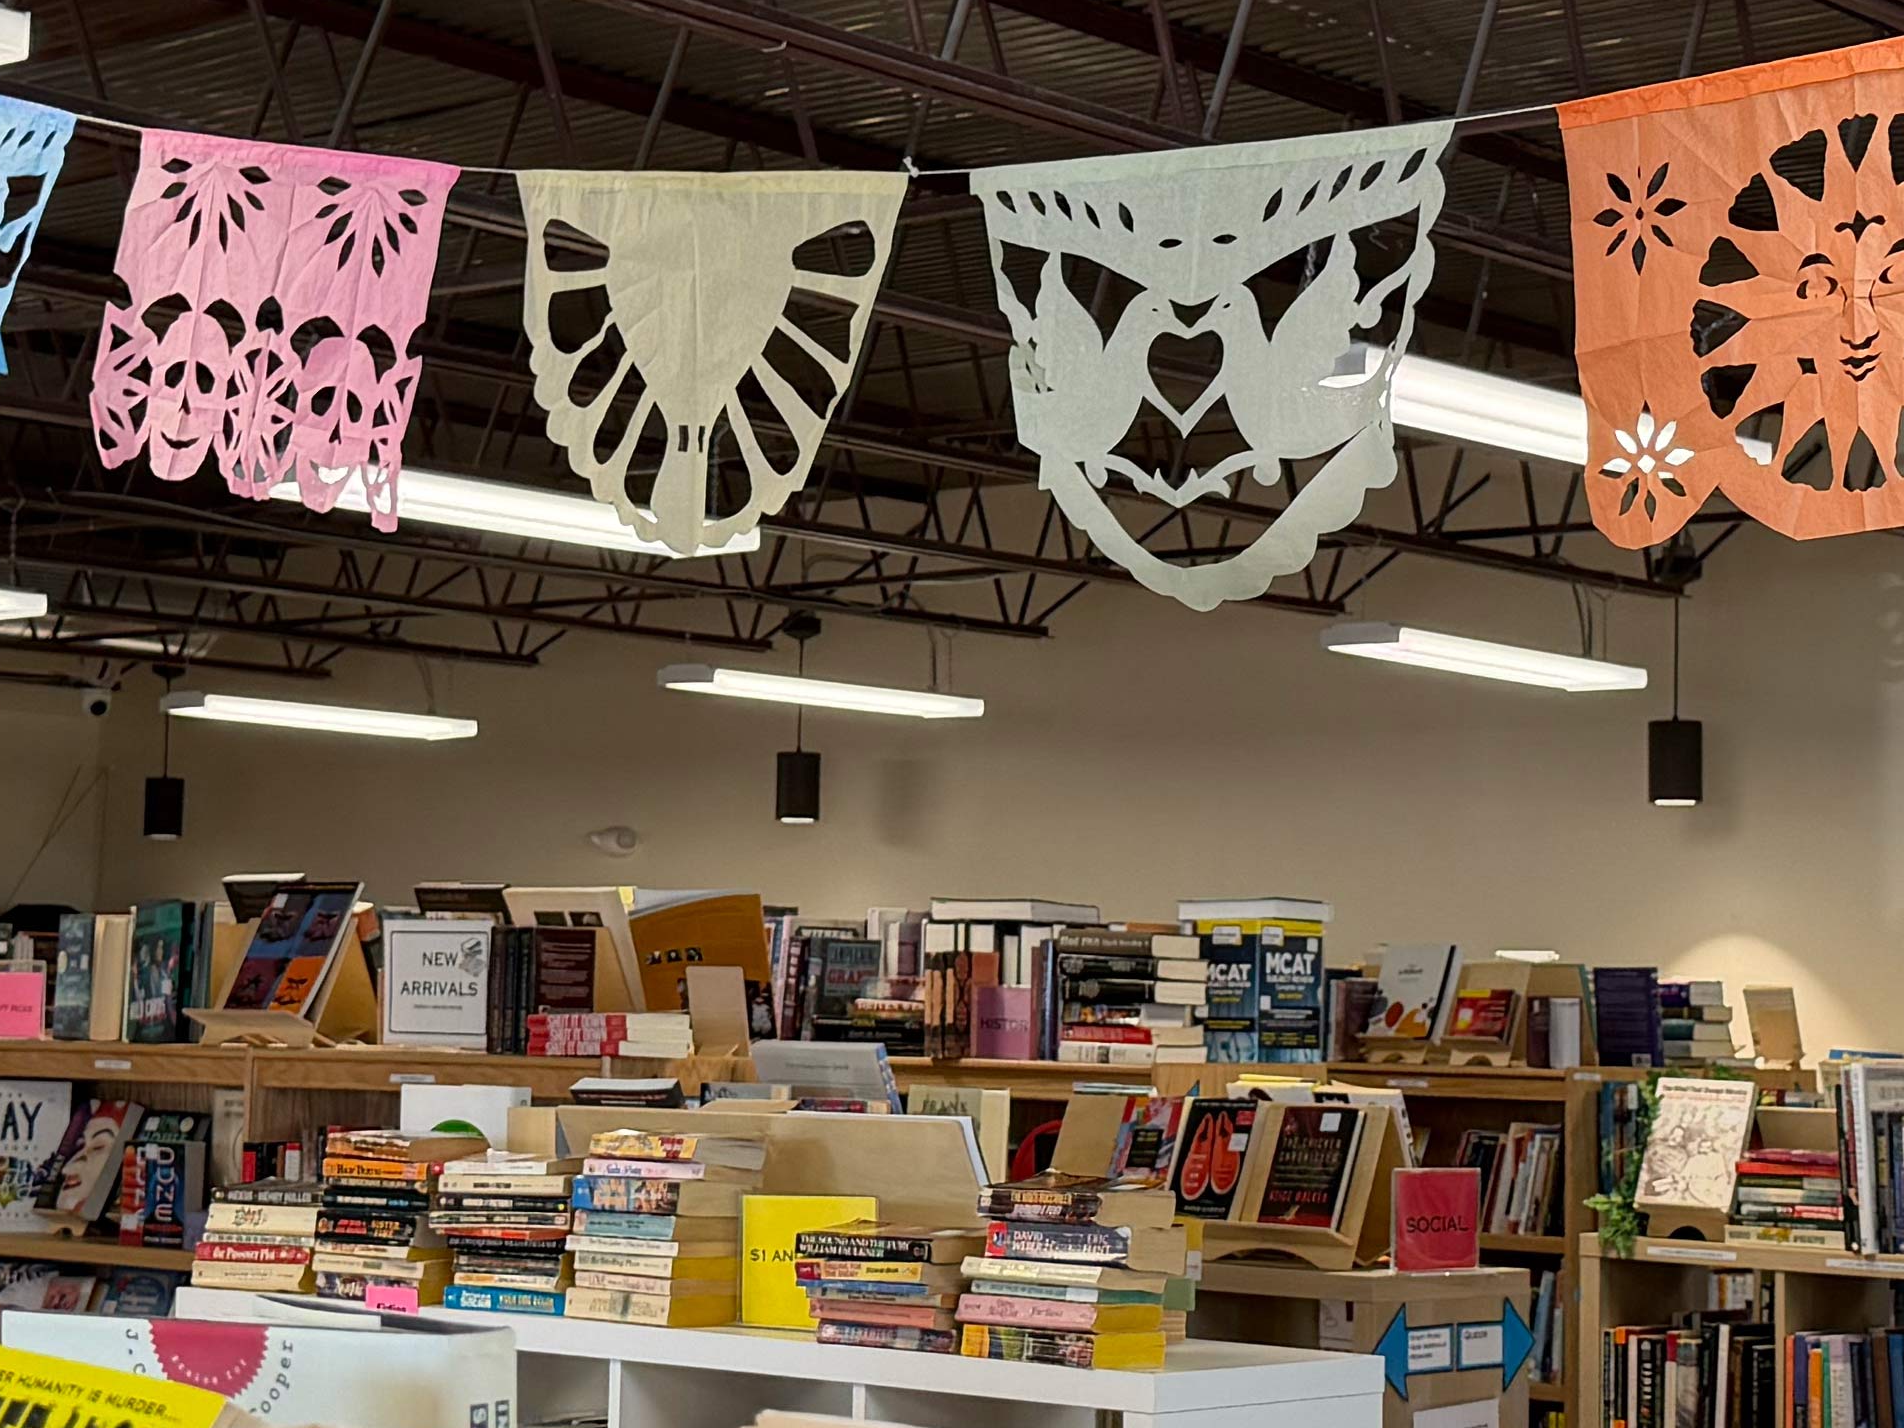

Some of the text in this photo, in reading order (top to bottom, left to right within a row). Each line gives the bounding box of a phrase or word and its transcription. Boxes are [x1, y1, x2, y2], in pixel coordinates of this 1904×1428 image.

[422, 951, 458, 967] NEW
[1265, 951, 1315, 975] MCAT
[401, 980, 478, 998] ARRIVALS
[156, 1145, 175, 1222] DUNE
[1406, 1215, 1469, 1235] SOCIAL
[1013, 1229, 1044, 1243] DAVID
[749, 1248, 768, 1263] $1
[17, 1373, 83, 1399] HUMANITY
[86, 1386, 102, 1401] IS
